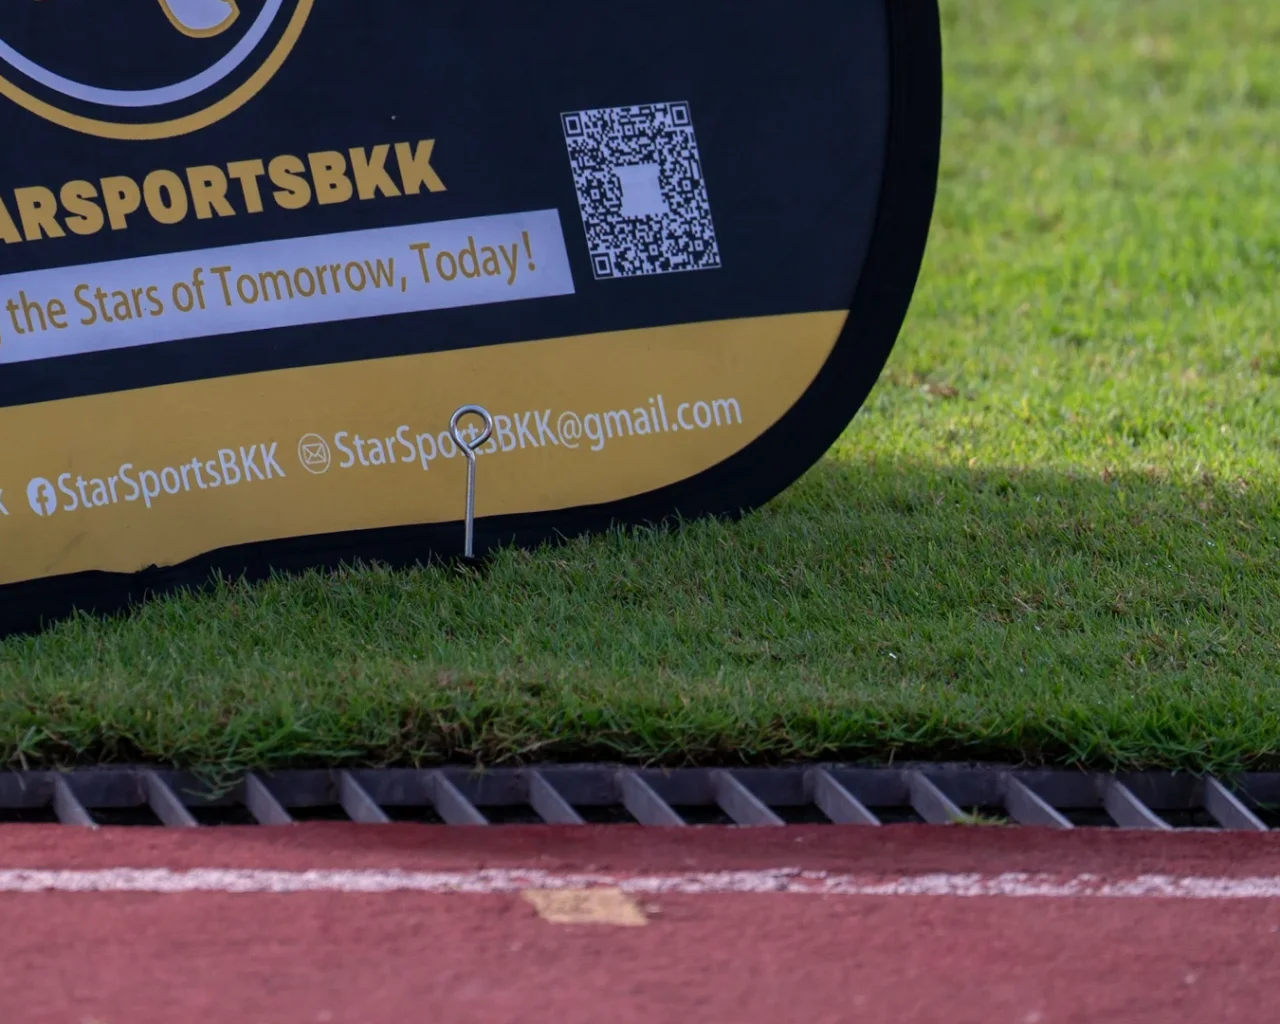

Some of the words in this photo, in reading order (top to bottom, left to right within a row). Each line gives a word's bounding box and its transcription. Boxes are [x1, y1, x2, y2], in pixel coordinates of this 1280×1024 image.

[6, 284, 69, 335] the
[77, 270, 165, 326] Stars
[171, 260, 208, 312] of
[211, 257, 408, 308] Tomorrow,
[409, 231, 536, 285] Today!
[58, 442, 286, 508] StarSportsBKK
